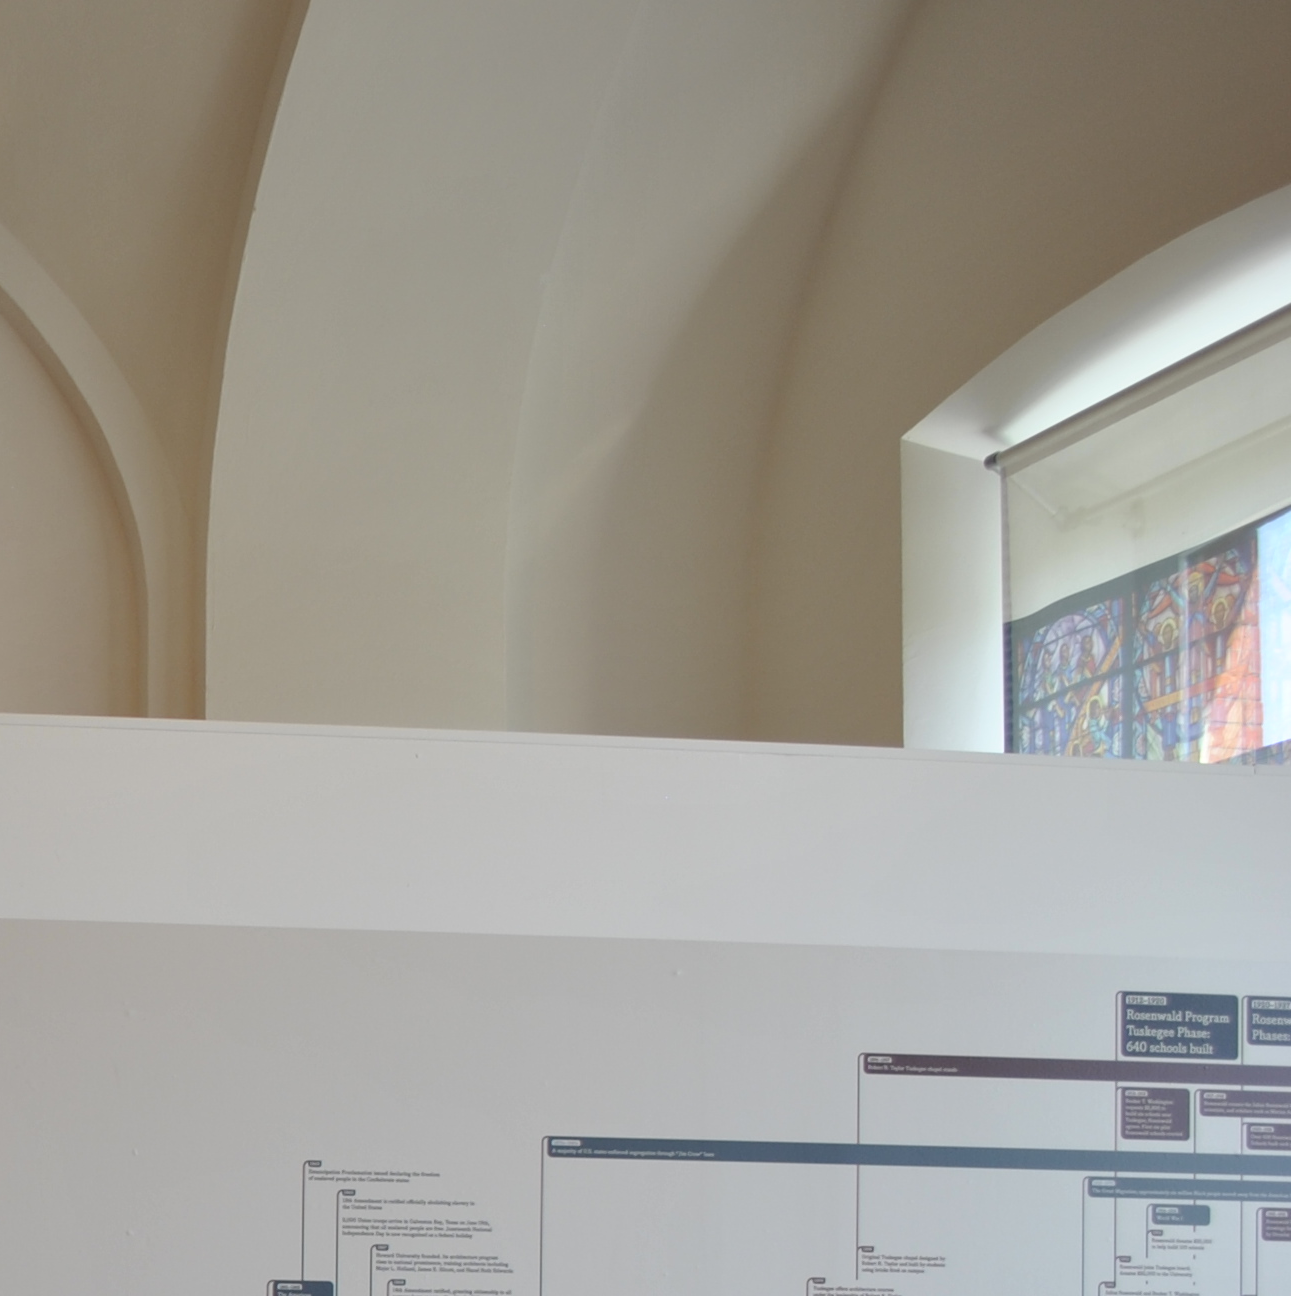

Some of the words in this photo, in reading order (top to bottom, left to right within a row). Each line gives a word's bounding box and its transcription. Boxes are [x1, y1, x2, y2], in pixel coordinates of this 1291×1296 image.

[1126, 1009, 1182, 1023] Rosenwald
[1185, 1011, 1230, 1026] Program
[1126, 1025, 1175, 1041] Tuskegee
[1177, 1027, 1211, 1039] Phase:
[1126, 1041, 1147, 1053] 640
[1149, 1042, 1187, 1054] schools
[1189, 1043, 1214, 1055] built
